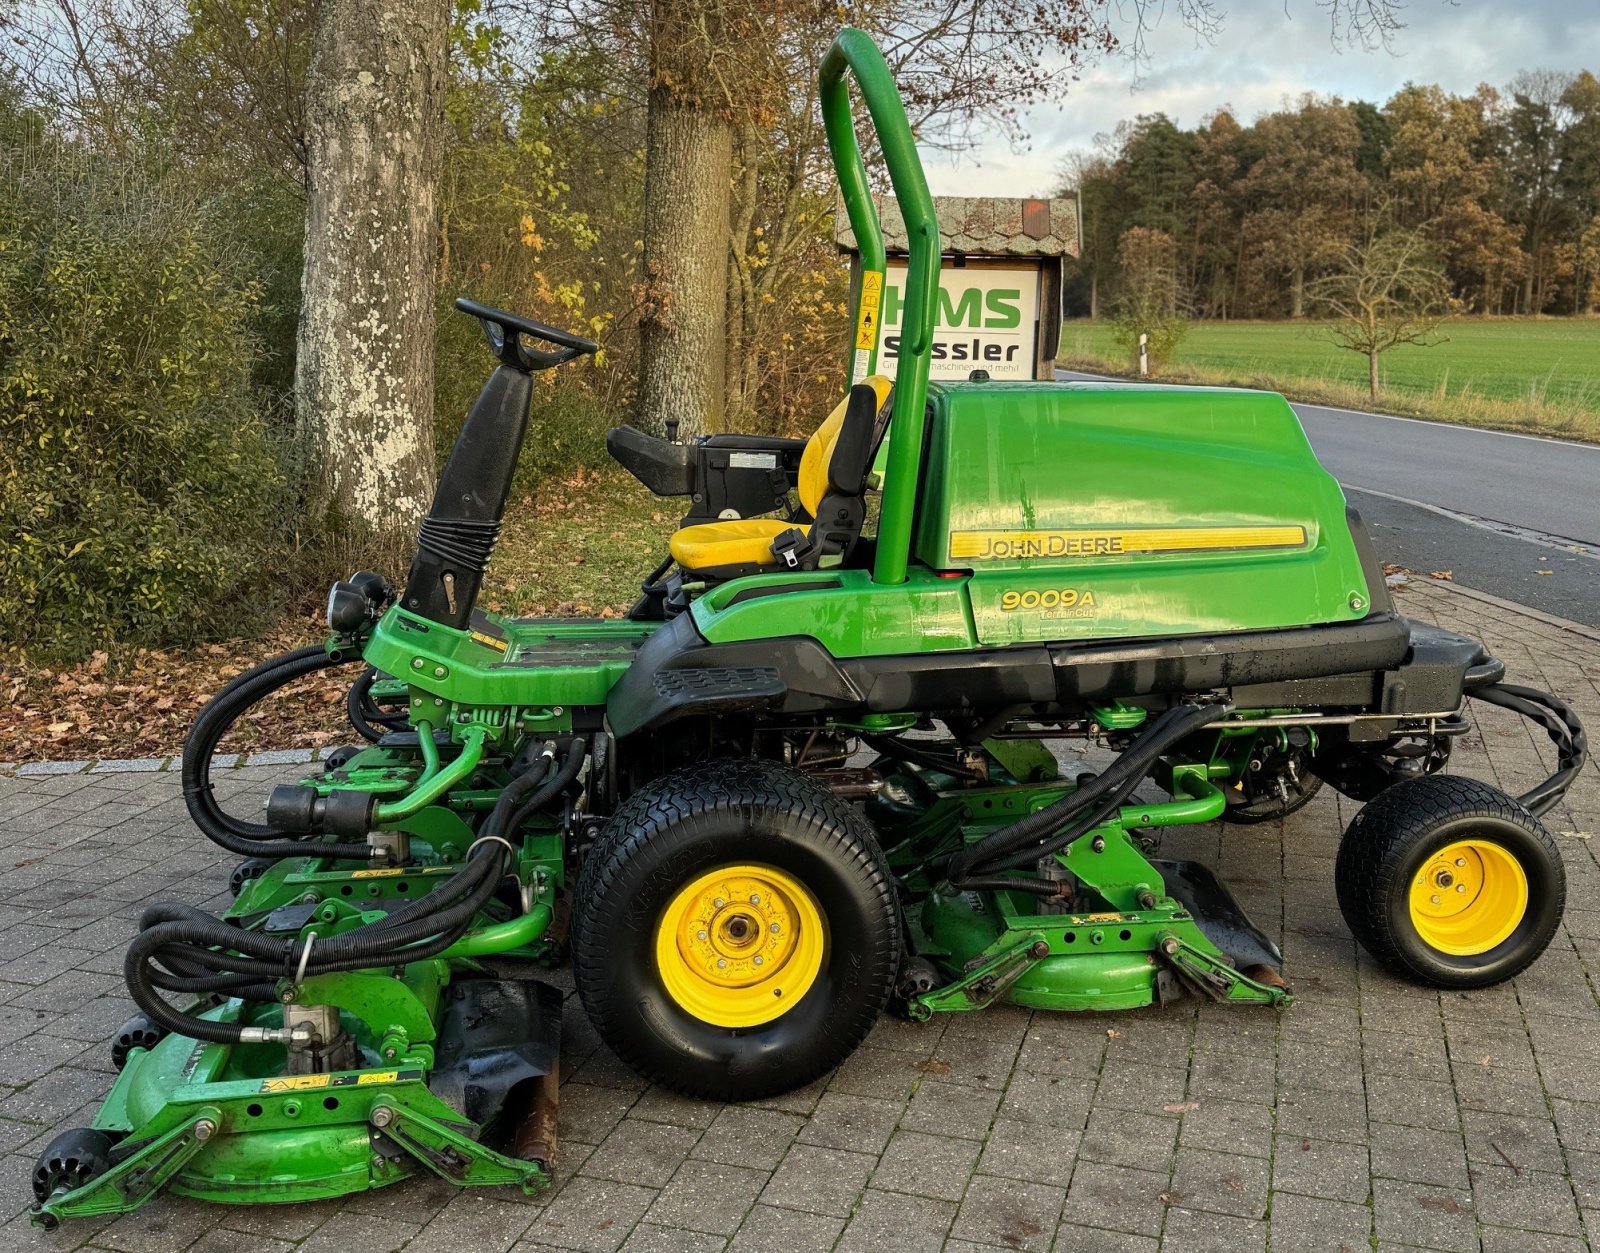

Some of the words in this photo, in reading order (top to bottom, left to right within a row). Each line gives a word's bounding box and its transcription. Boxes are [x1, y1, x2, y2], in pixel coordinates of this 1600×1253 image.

[884, 336, 1019, 361] Sssler
[980, 538, 1042, 556] JOHN
[1049, 536, 1123, 553] DEERE
[1002, 588, 1095, 610] 9009A
[1040, 608, 1094, 619] TerrainCut
